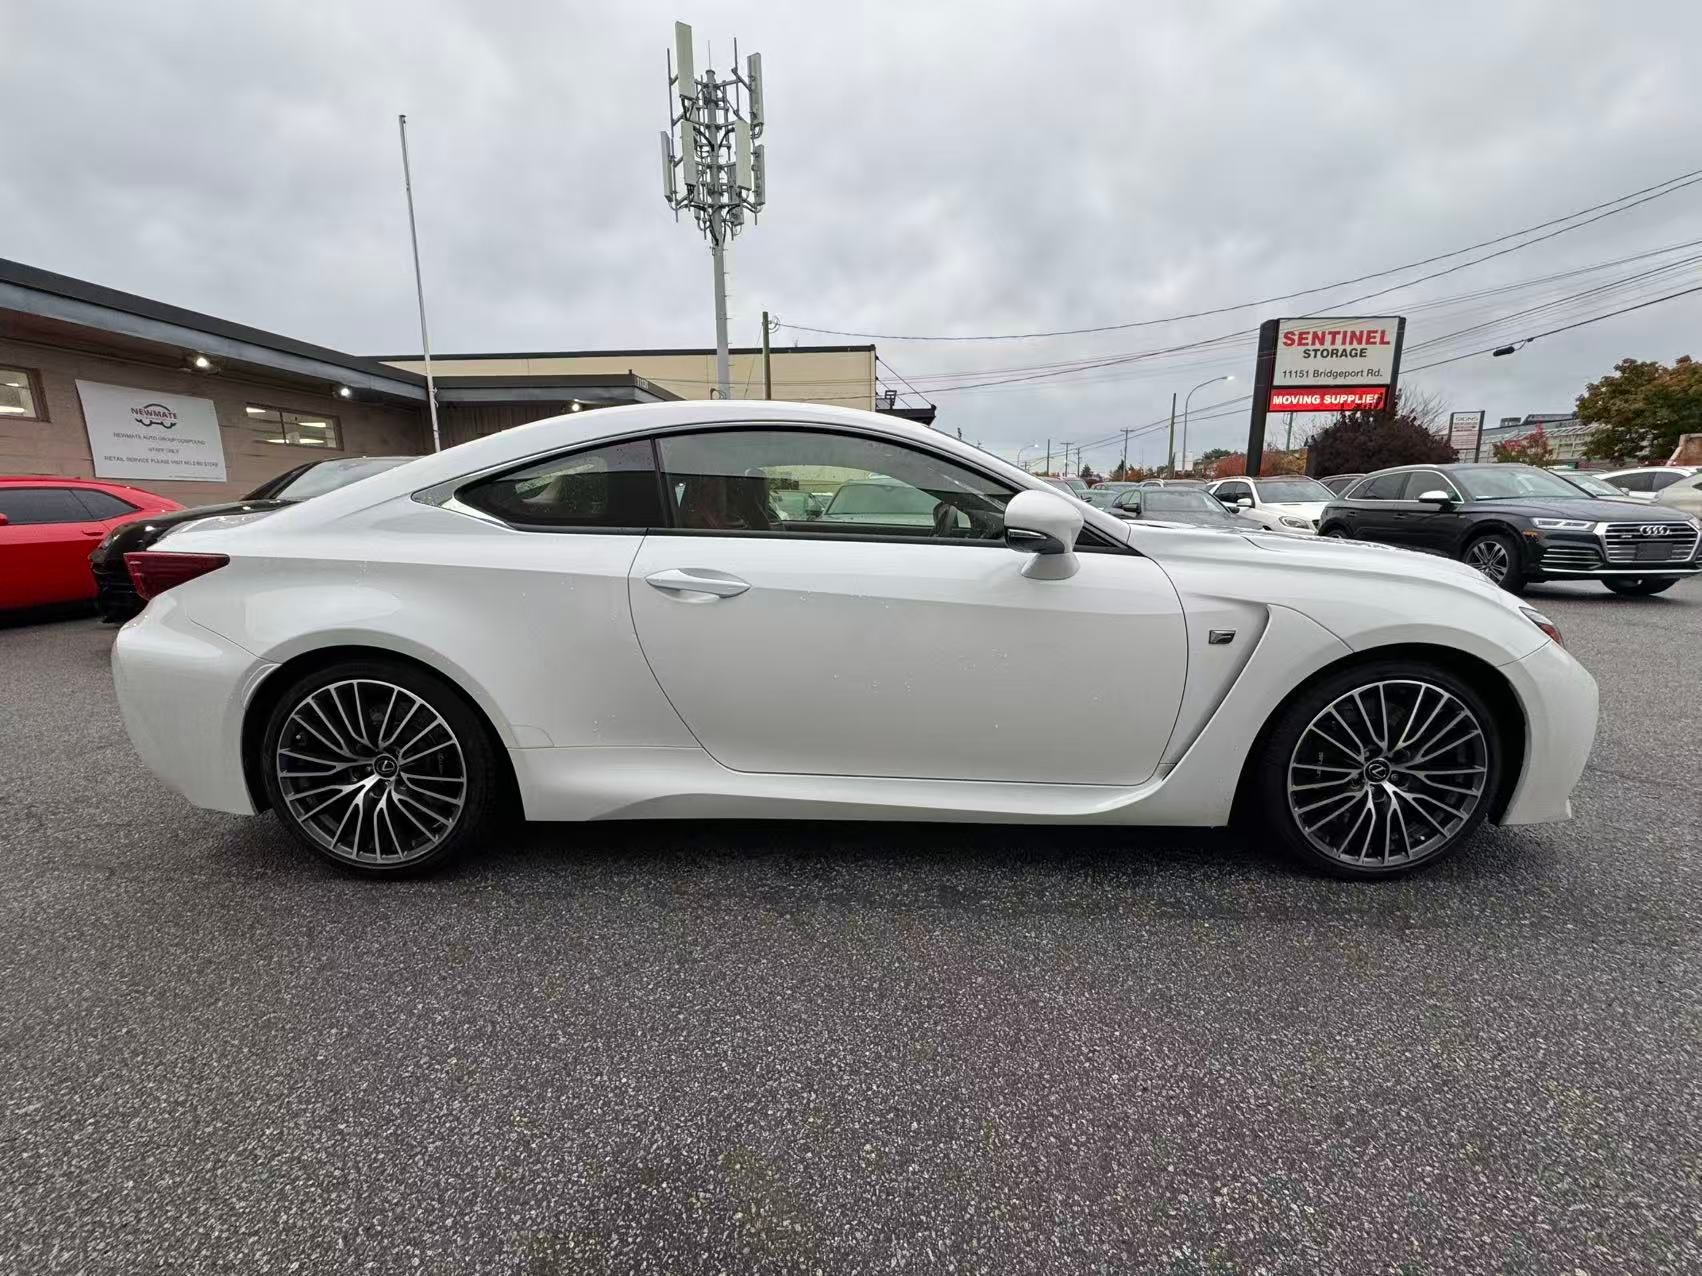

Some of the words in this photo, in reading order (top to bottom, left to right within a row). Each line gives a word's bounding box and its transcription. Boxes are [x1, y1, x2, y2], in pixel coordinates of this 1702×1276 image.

[1282, 329, 1391, 347] SENTINEL
[1302, 347, 1368, 359] STORAGE
[1282, 369, 1309, 379] 11151
[1312, 367, 1364, 380] Bridgeport
[1366, 368, 1383, 377] Rd.
[1272, 394, 1321, 405] MOVING
[130, 407, 177, 420] NEWMATE
[113, 432, 142, 440] NEWMATE
[126, 456, 150, 464] SERVICE
